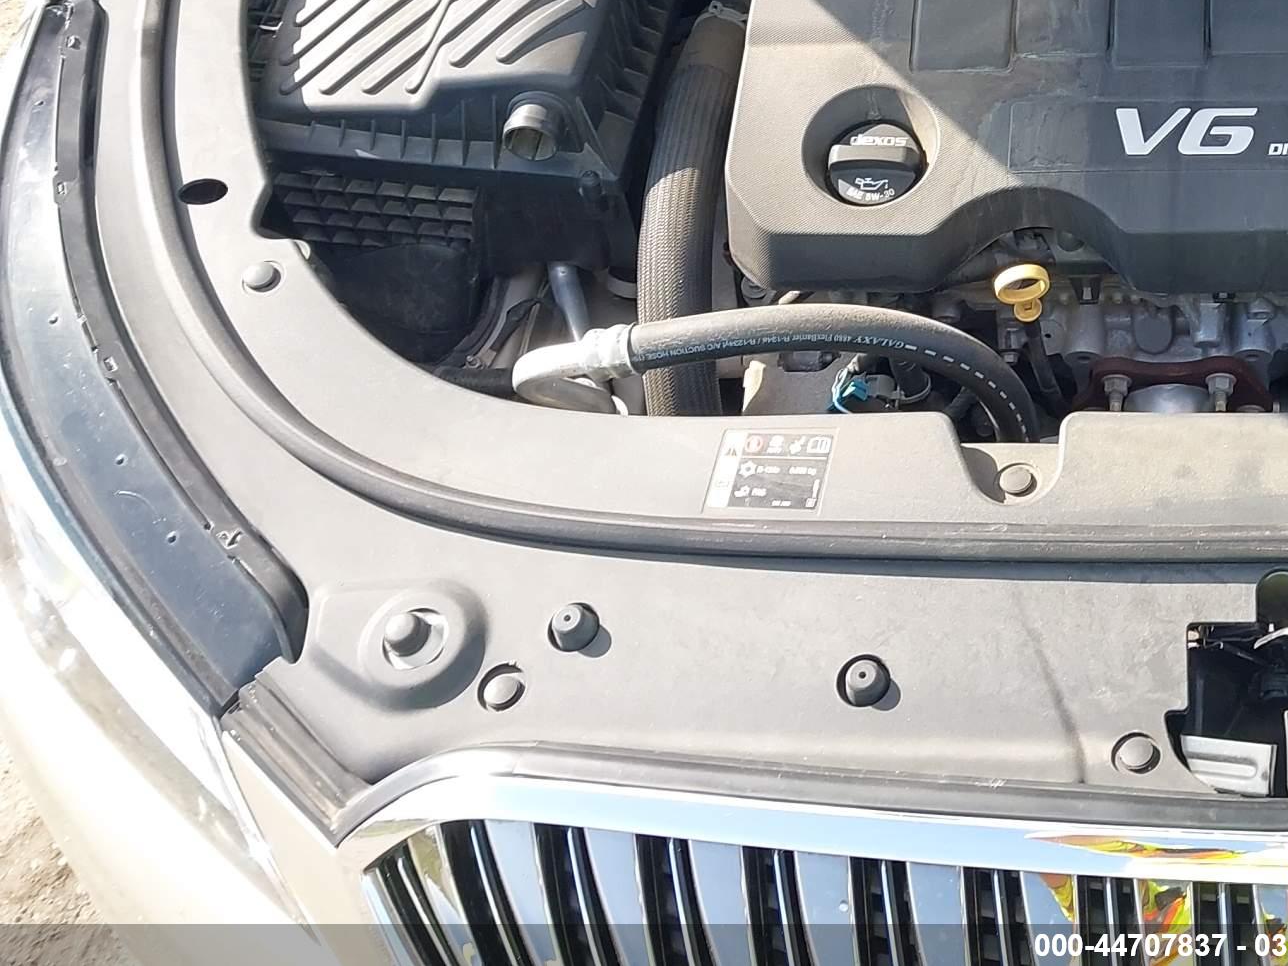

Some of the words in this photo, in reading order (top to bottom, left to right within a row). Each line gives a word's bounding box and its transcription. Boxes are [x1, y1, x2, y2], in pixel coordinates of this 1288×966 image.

[1114, 107, 1258, 156] V6
[850, 134, 909, 146] dexos
[865, 188, 895, 201] 5W-30
[853, 336, 904, 349] GALAXY
[670, 346, 706, 356] SUCTION
